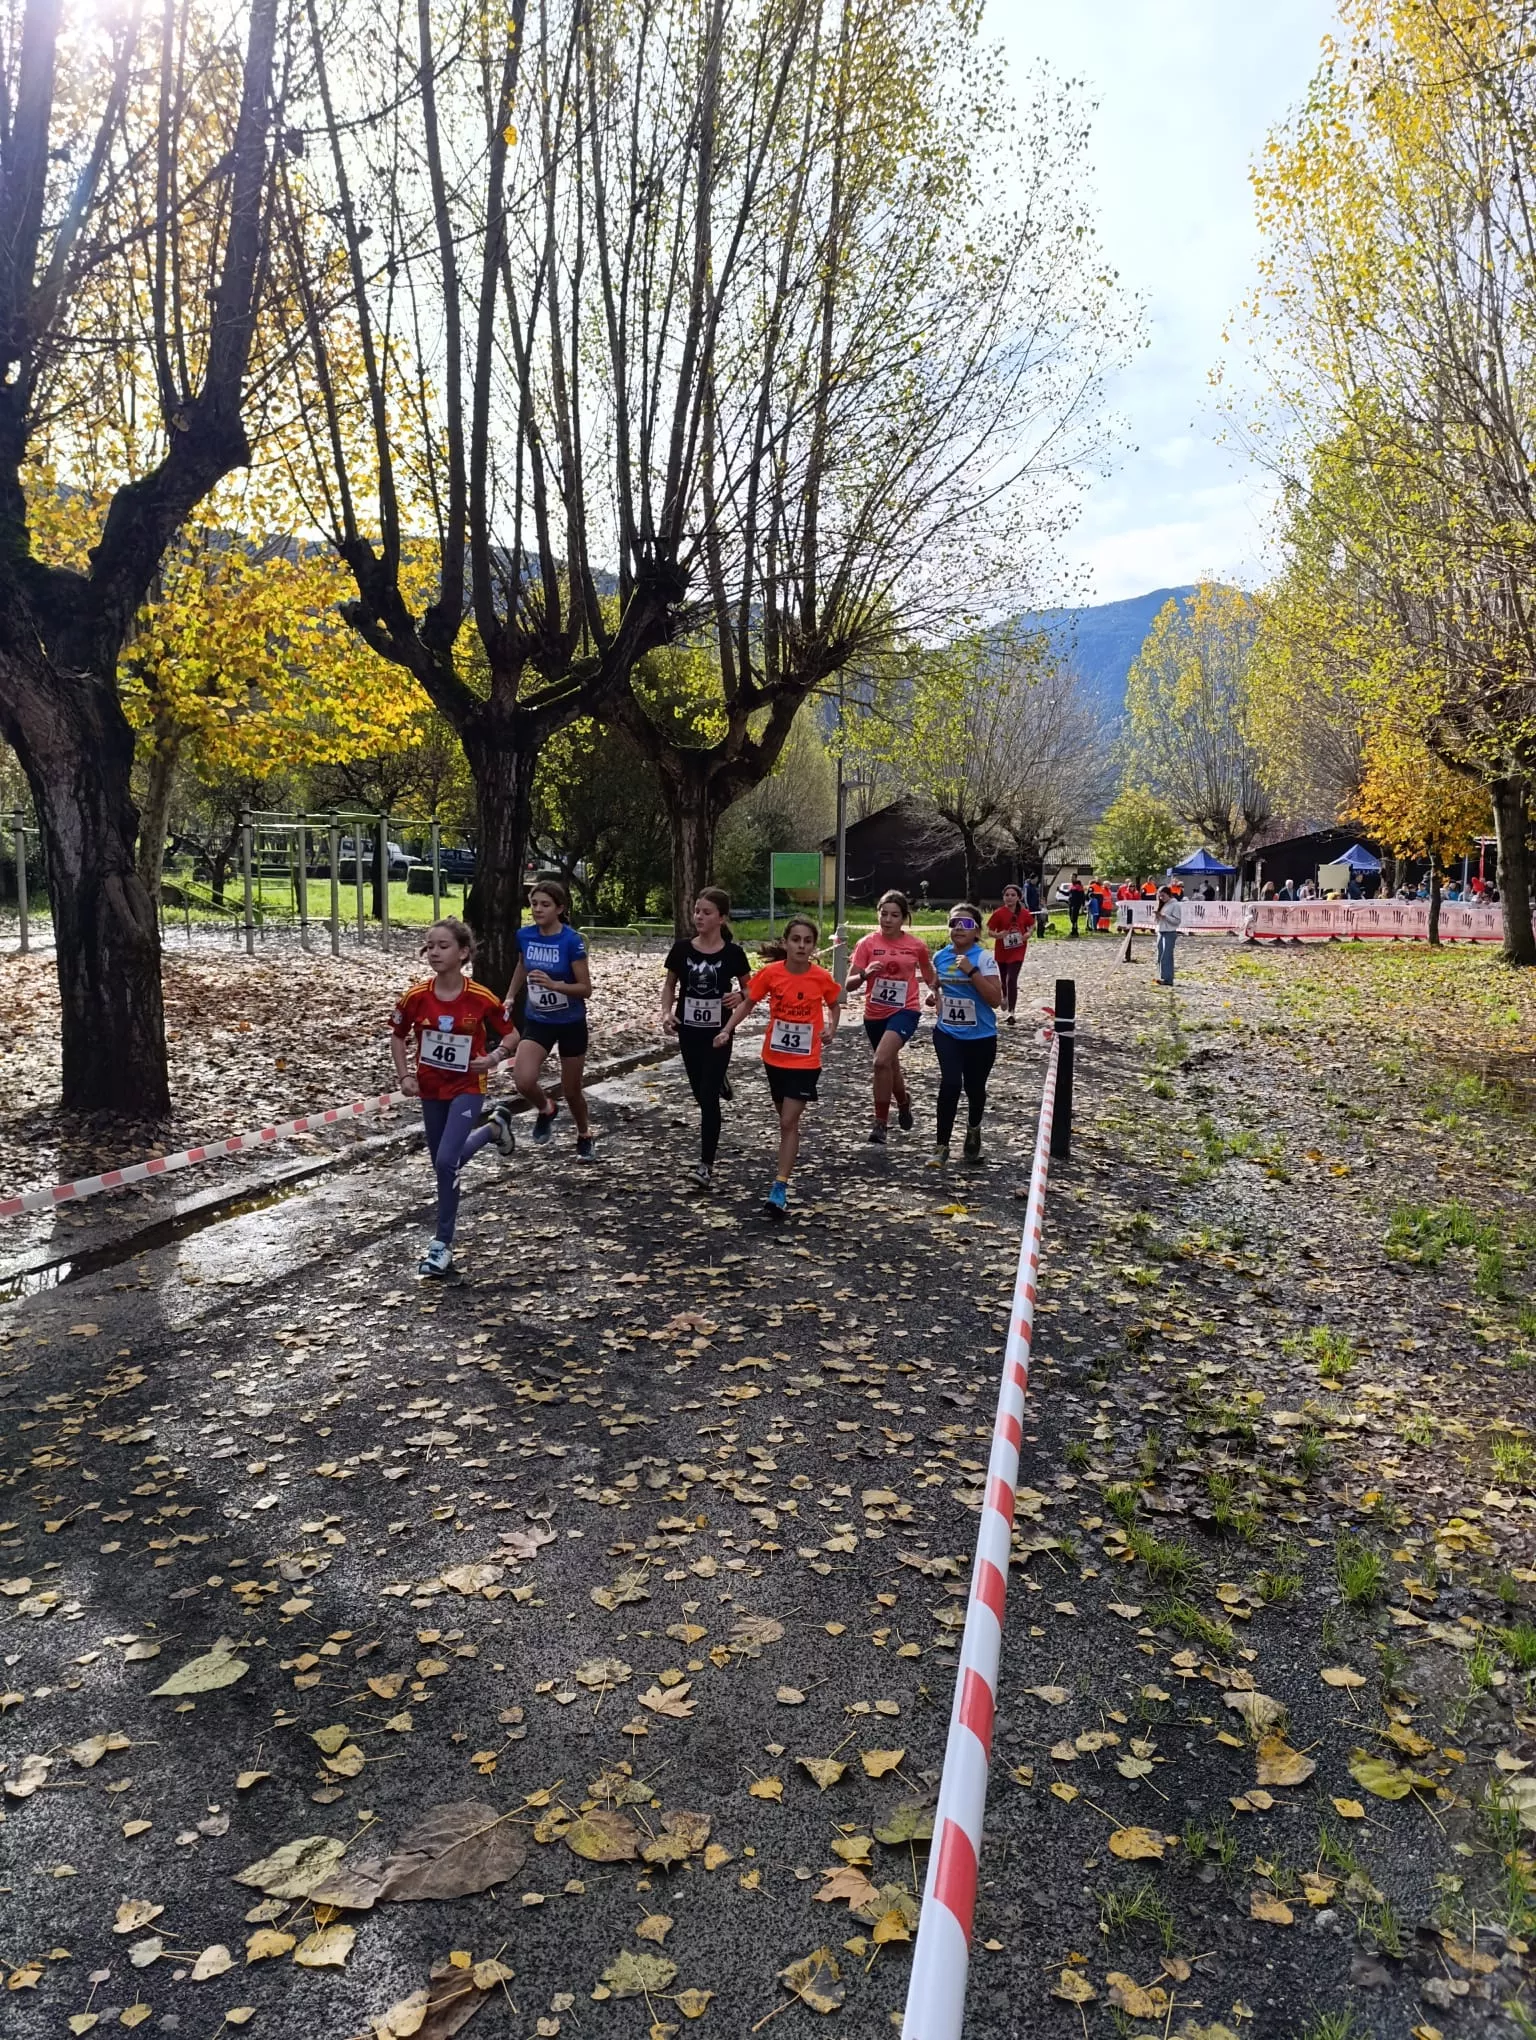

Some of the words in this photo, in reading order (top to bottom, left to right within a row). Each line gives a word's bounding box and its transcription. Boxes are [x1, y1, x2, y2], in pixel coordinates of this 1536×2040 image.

[526, 945, 560, 963] GMMB
[539, 993, 557, 1006] 40
[880, 989, 897, 1002] 42
[693, 1009, 711, 1022] 60
[949, 1008, 966, 1021] 44
[781, 1033, 801, 1048] 43
[432, 1045, 456, 1063] 46
